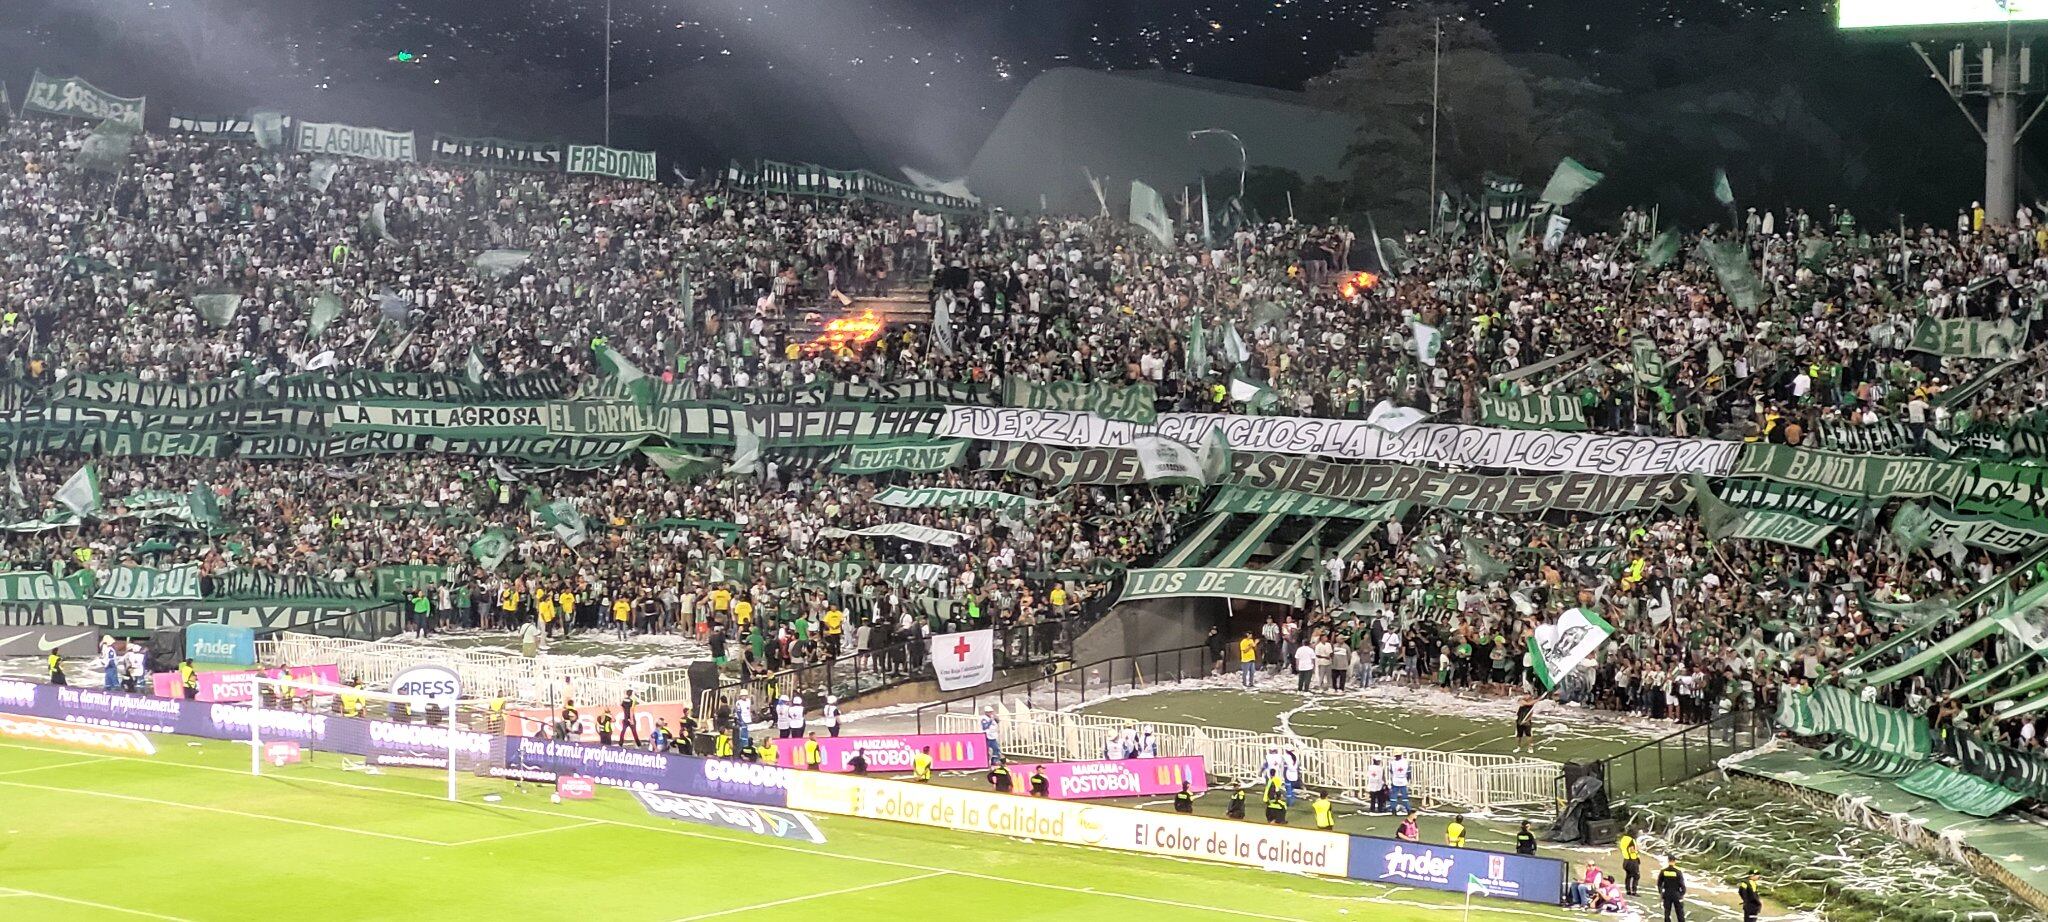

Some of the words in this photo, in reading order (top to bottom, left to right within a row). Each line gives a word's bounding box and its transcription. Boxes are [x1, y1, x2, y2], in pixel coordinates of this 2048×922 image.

[302, 126, 322, 150] EL
[326, 128, 411, 158] AGUANTE
[570, 146, 655, 180] FREDONIA
[337, 405, 371, 424] LA
[392, 406, 541, 427] MILAGROSA
[551, 405, 575, 432] EL
[681, 405, 734, 440] LA
[746, 405, 863, 443] MAFIA
[869, 405, 946, 441] 1989
[102, 432, 133, 457] LA
[140, 431, 219, 458] CEJA
[249, 431, 409, 458] RIONEGRO
[443, 434, 626, 460] ENVIGADO
[854, 446, 953, 469] GUARNE
[950, 407, 1091, 444] FUERZA
[1377, 426, 1501, 465] BARRA
[1504, 433, 1582, 467] LOS
[1577, 436, 1742, 477] ESPERA!!
[1743, 445, 1777, 473] LA
[1787, 451, 1867, 491] BANDA
[1878, 460, 1964, 499] PIRATA
[104, 566, 198, 599] IBAGUE
[1131, 572, 1186, 595] LOS
[1197, 572, 1235, 592] DE
[520, 738, 545, 756] Para
[584, 746, 667, 769] profundamente
[1061, 768, 1140, 794] POSTOBÓN
[1073, 763, 1119, 777] MANZANA
[641, 790, 766, 836] BetPlay
[930, 801, 954, 823] de
[961, 802, 980, 825] la
[987, 803, 1066, 838] Calidad
[1134, 823, 1150, 847] El
[1155, 826, 1204, 853] Color
[1206, 830, 1228, 855] de
[1233, 833, 1252, 858] la
[1256, 836, 1328, 869] Calidad
